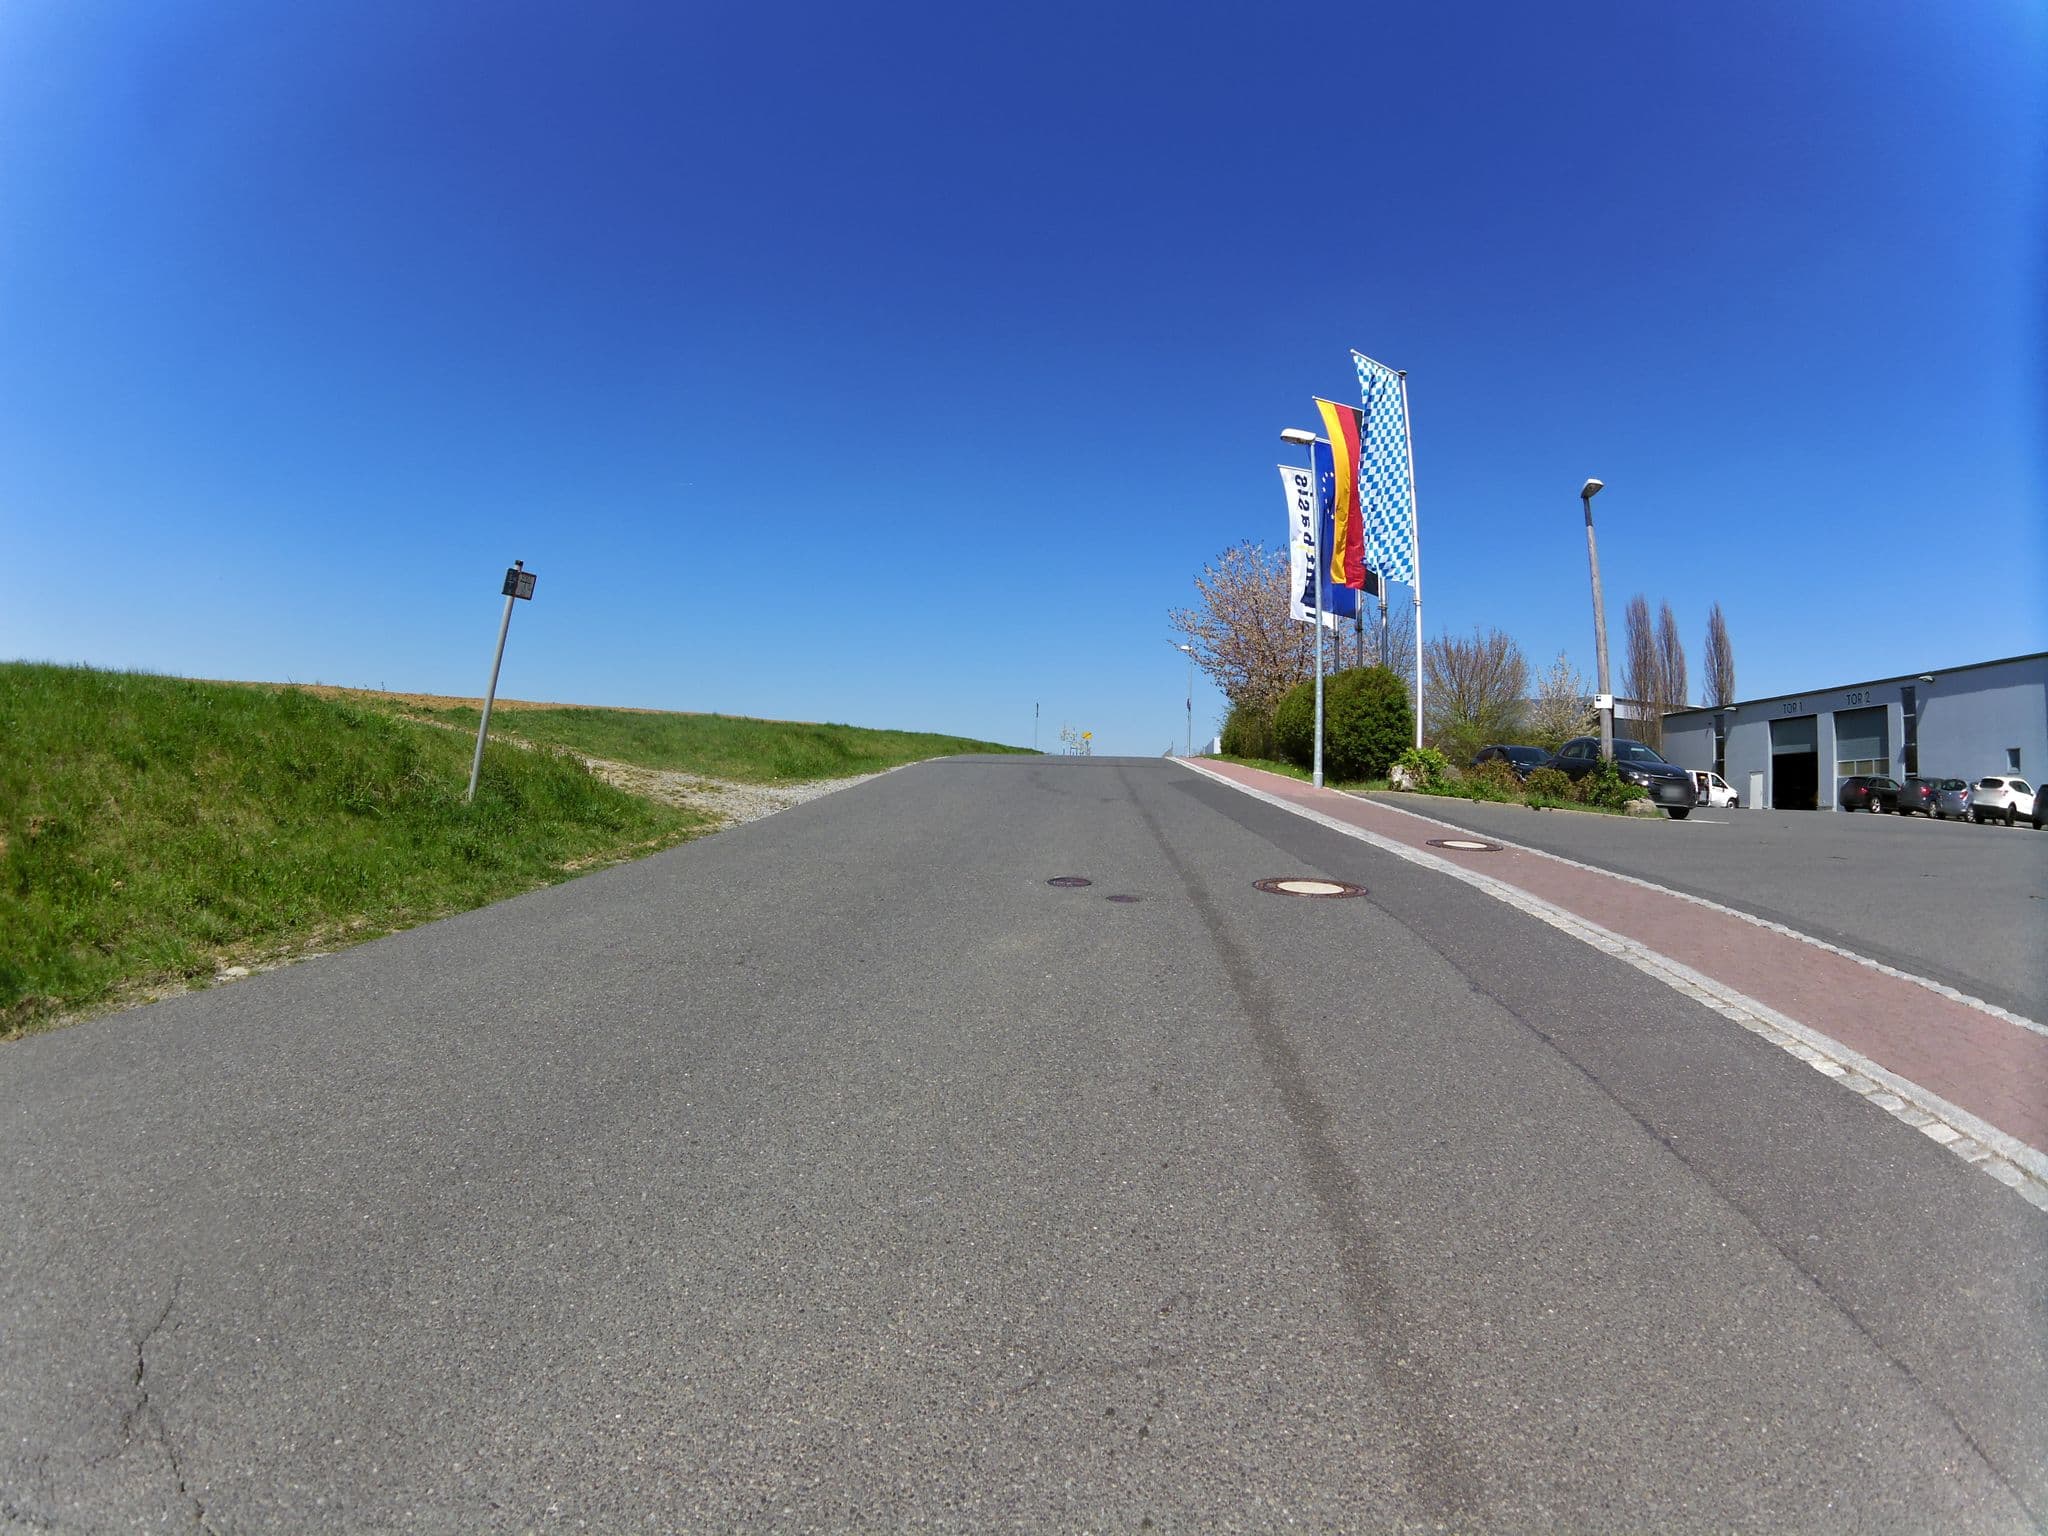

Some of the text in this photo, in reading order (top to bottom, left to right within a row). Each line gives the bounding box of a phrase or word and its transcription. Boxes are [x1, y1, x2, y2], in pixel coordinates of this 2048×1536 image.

[1846, 690, 1870, 705] TOR 2
[1782, 702, 1797, 714] TOR
